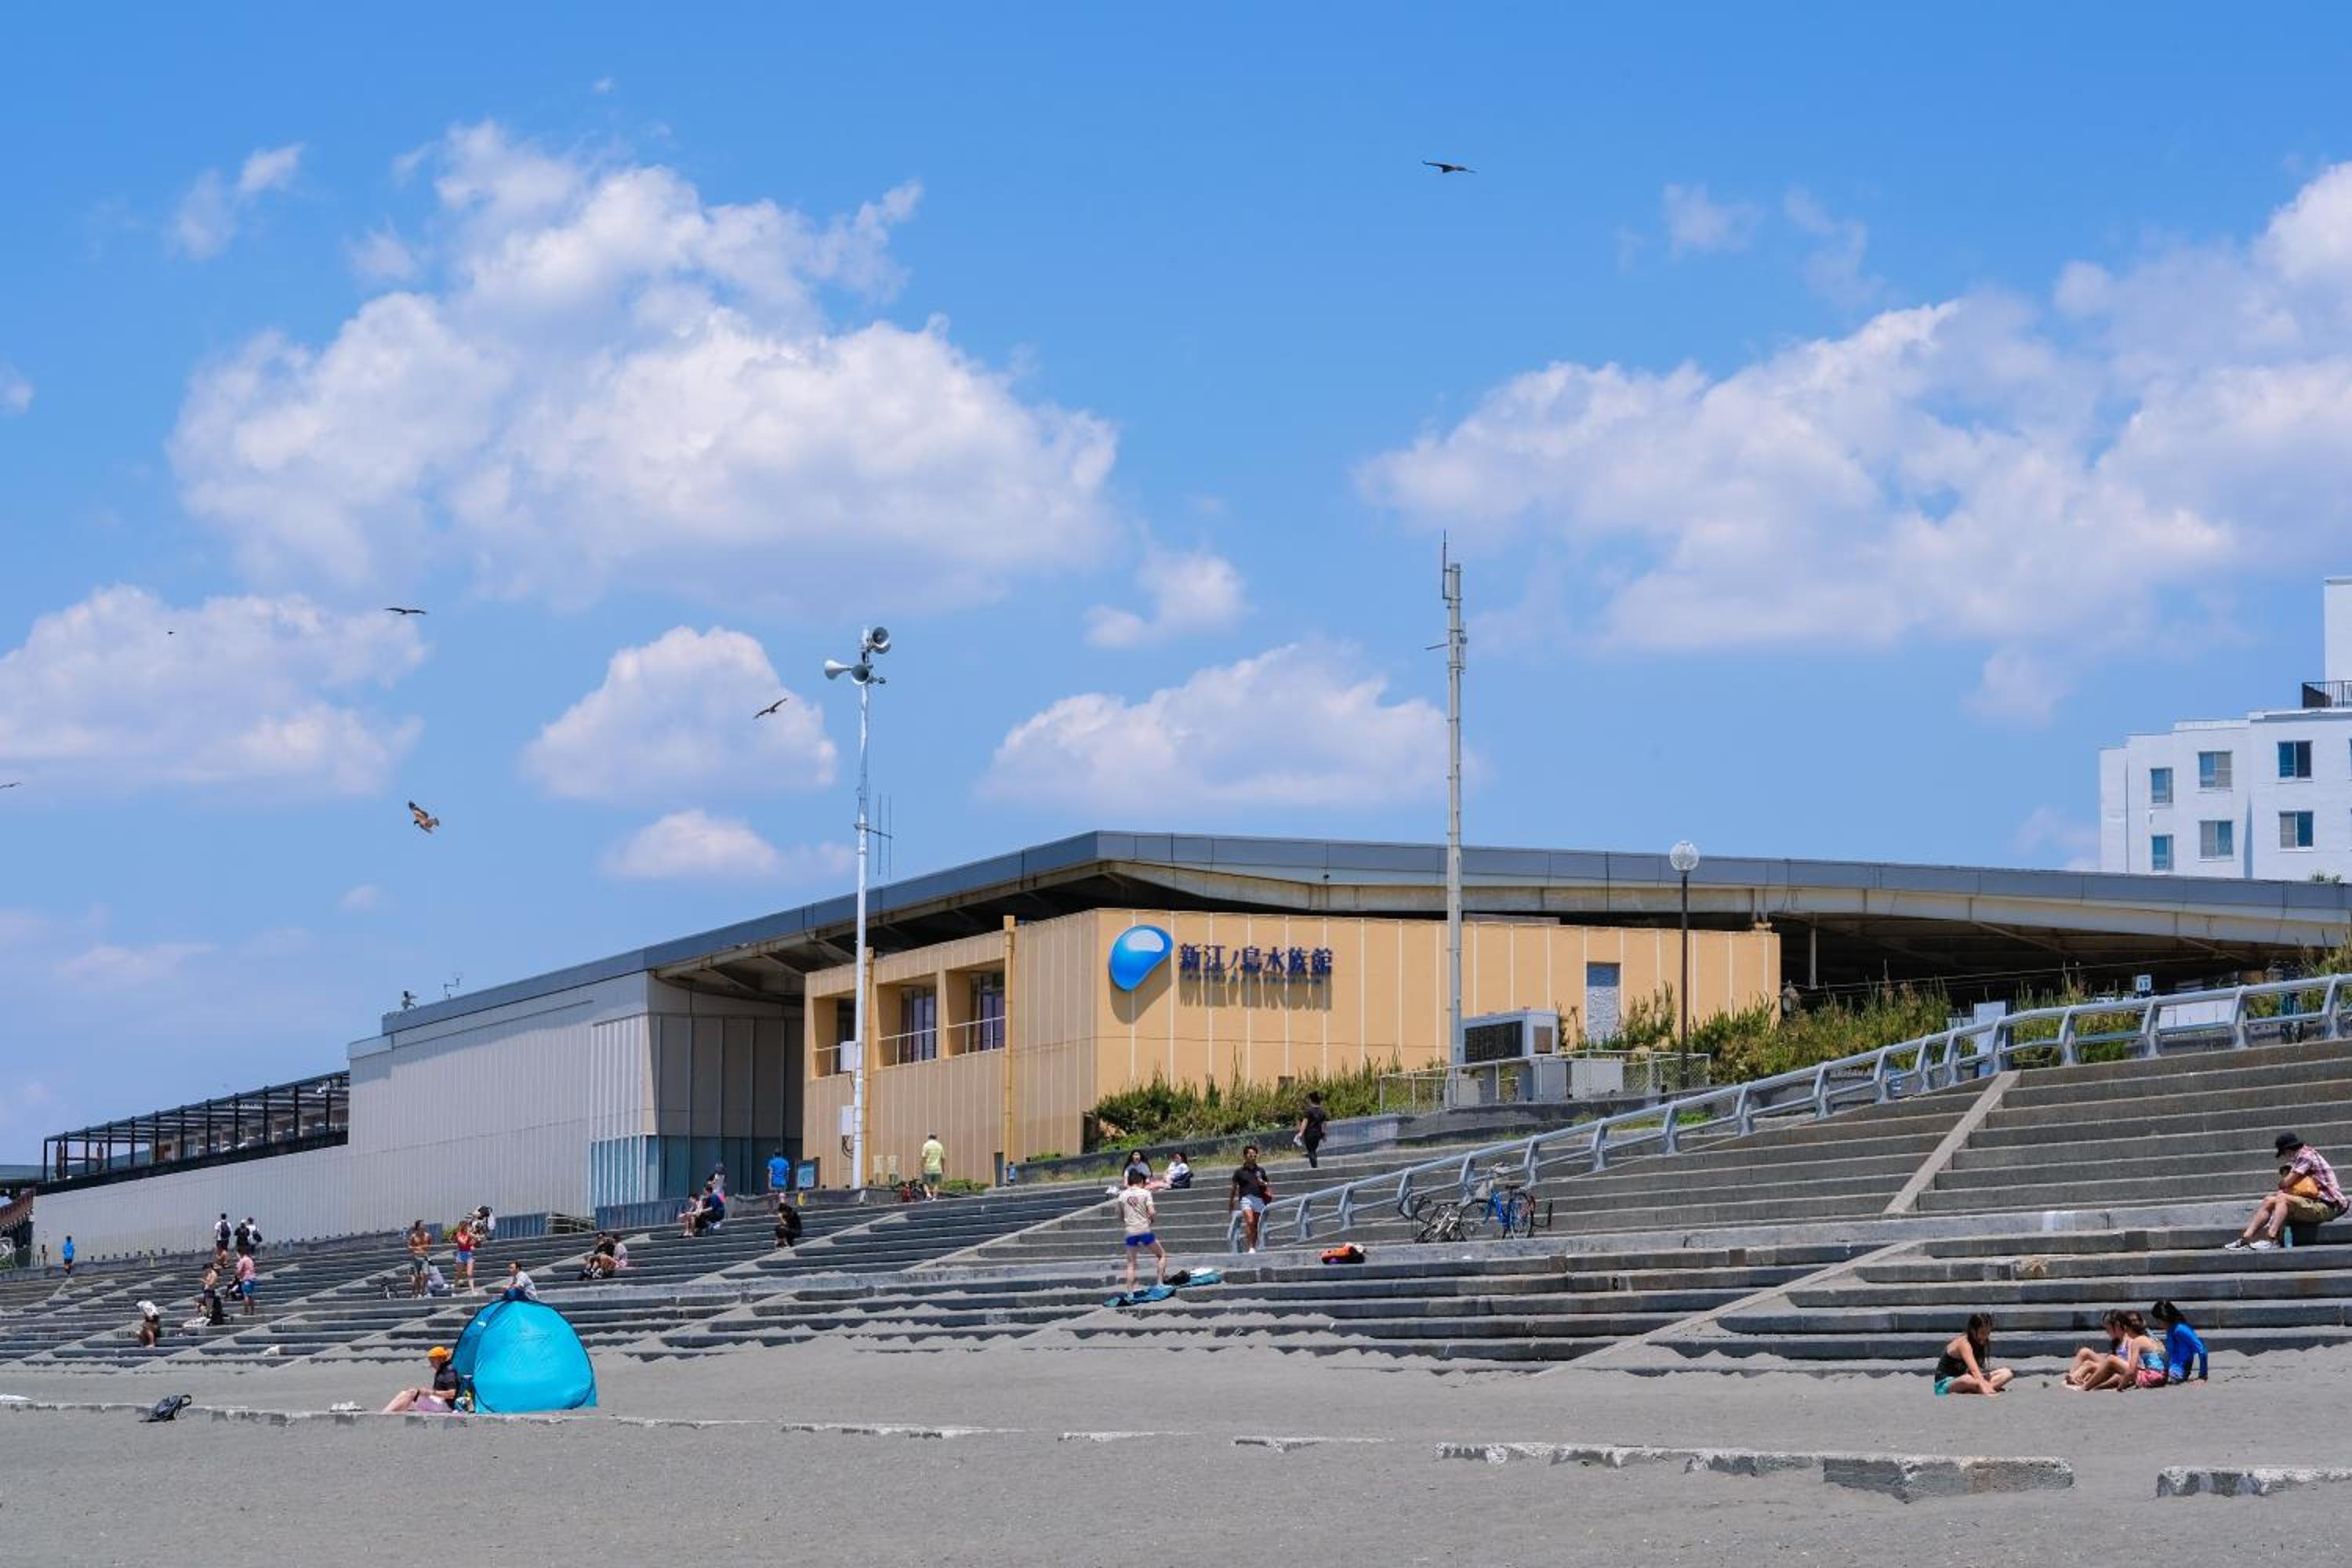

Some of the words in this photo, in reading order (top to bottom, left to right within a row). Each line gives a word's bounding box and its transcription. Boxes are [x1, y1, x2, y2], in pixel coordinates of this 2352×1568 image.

[1179, 943, 1332, 975] 新江ノ島水族館
